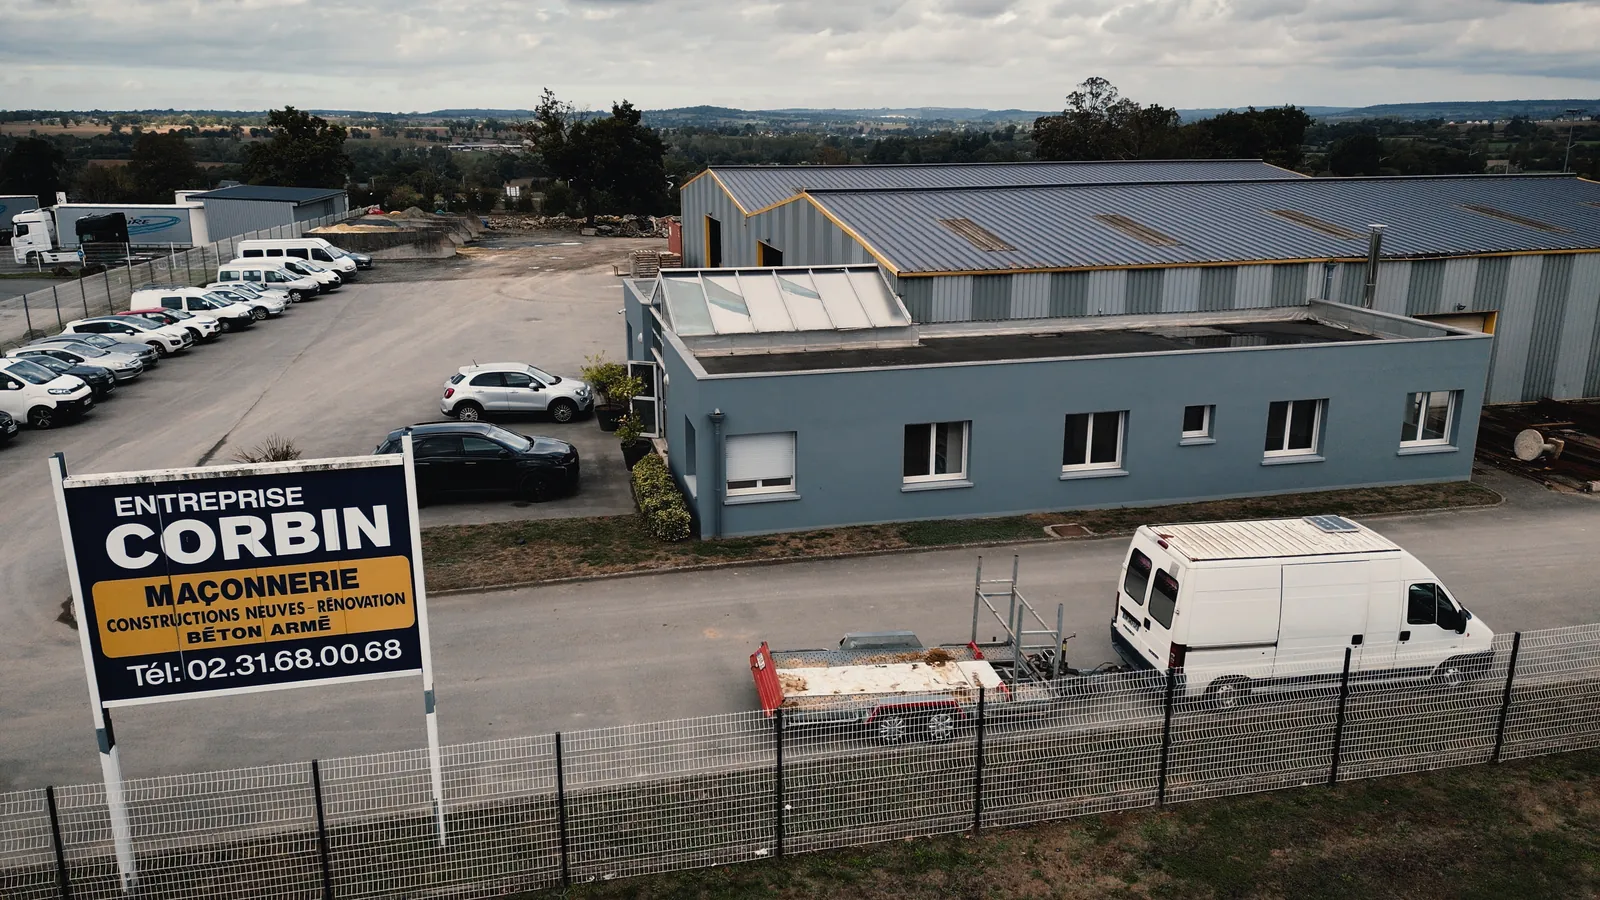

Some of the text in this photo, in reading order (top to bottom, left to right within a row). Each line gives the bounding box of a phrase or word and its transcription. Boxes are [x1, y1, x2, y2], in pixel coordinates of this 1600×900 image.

[114, 487, 305, 517] ENTREPRISE
[105, 504, 391, 570] CORBIN
[144, 567, 360, 607] MAÇONNERIE
[106, 606, 240, 633] CONSTRUCTIONS
[245, 600, 306, 620] NEUVES
[316, 592, 406, 613] RÉNOVATION
[186, 615, 332, 644] BÉTON ARMÉ
[126, 639, 402, 687] Tél: 02.31.68.00.68
